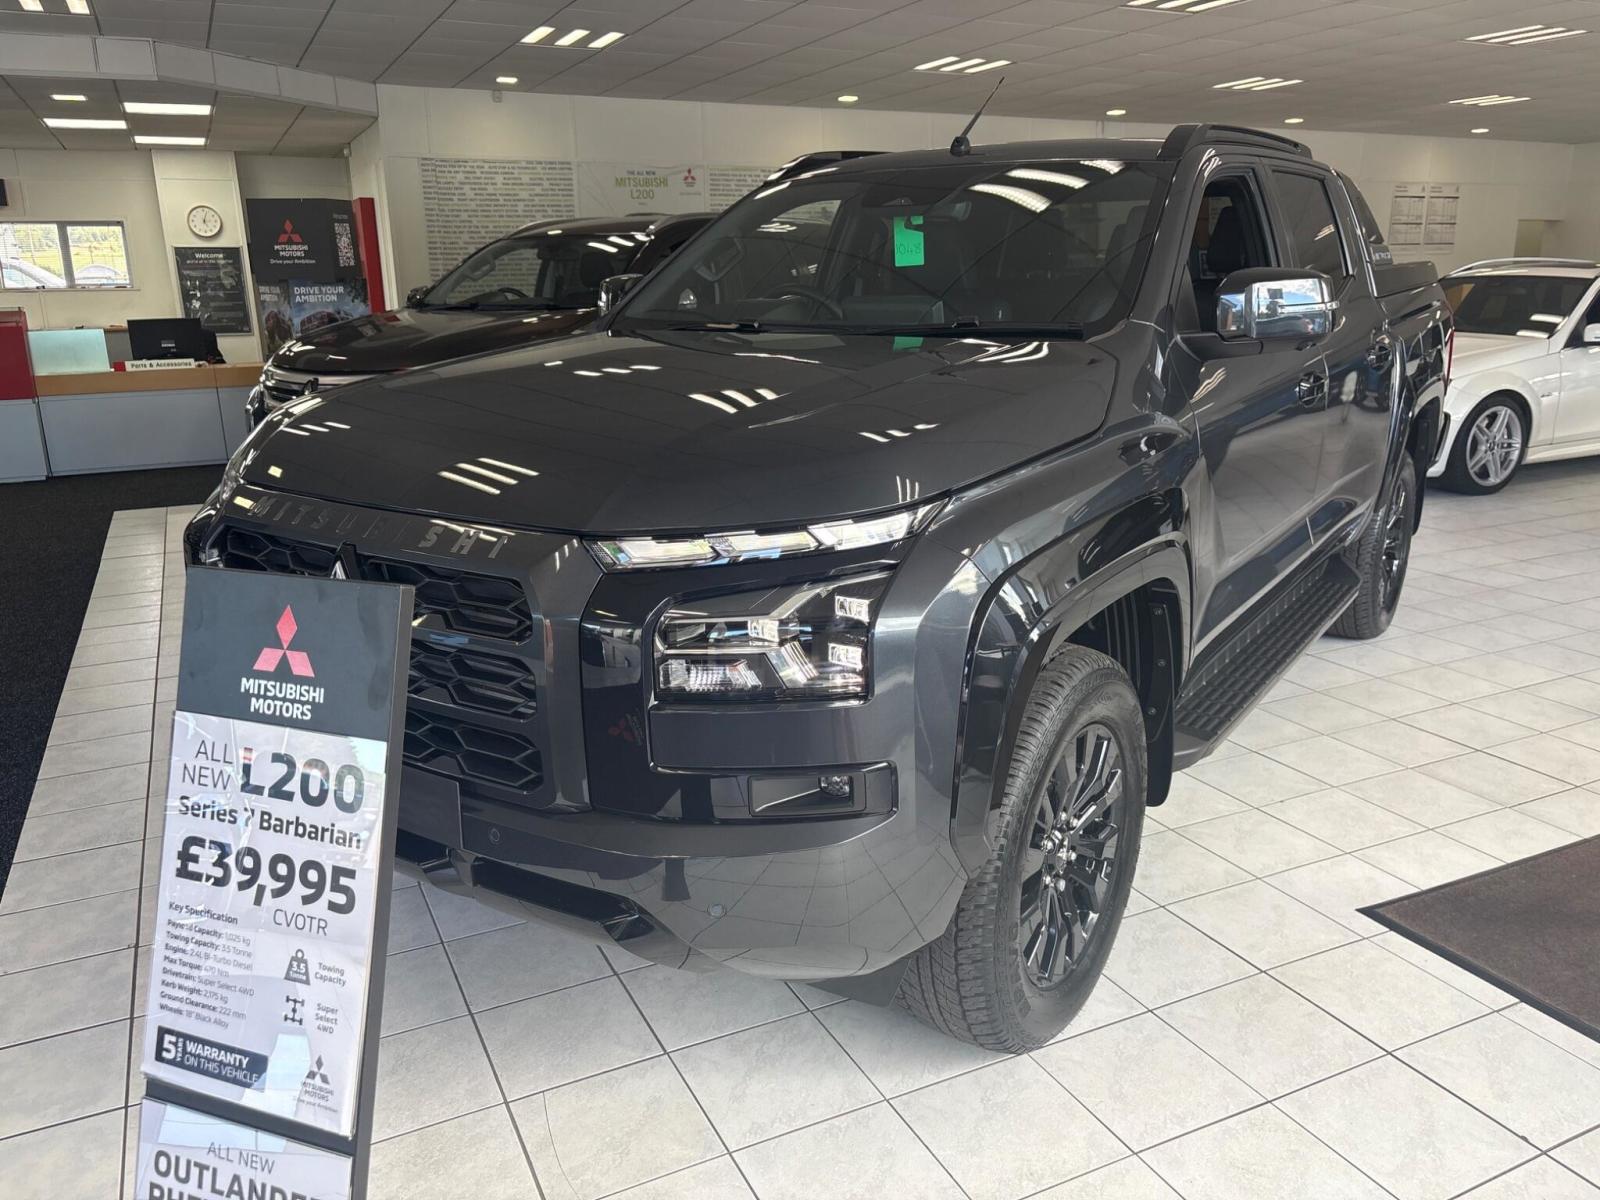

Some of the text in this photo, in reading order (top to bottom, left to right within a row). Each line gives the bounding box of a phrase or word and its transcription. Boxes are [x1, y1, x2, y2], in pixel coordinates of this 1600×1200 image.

[615, 176, 669, 188] MITSUBISHI
[630, 190, 655, 200] L200
[296, 294, 338, 303] AMBITION
[322, 286, 344, 294] YOUR
[240, 677, 324, 704] MITSUBISHI
[250, 697, 312, 720] MOTORS
[195, 740, 233, 765] ALL
[182, 763, 231, 791] NEW
[240, 747, 365, 814] L200
[179, 795, 238, 825] Series
[259, 811, 361, 849] Barbarian
[176, 835, 357, 915] £39,995
[168, 901, 238, 925] Key Specification
[273, 909, 328, 936] CVOTR
[165, 942, 189, 954] Engine:
[166, 930, 190, 945] Towing
[191, 936, 221, 951] Capacity:
[164, 955, 177, 965] Max
[291, 960, 306, 973] 3.5
[318, 962, 345, 976] Towing
[161, 979, 177, 989] Kerb
[198, 975, 216, 987] Super
[217, 980, 237, 993] Select
[315, 971, 347, 987] Capacity
[160, 991, 185, 1003] Ground
[317, 1003, 338, 1016] Super
[212, 1017, 229, 1029] Alloy
[315, 1013, 338, 1026] Select
[316, 1023, 334, 1034] 4WD
[162, 1033, 177, 1060] 5
[186, 1040, 250, 1069] WARRANTY
[184, 1054, 259, 1083] ON THIS VEHICLE
[304, 1089, 329, 1102] MOTORS
[207, 1142, 276, 1174] ALL NEW
[154, 1150, 321, 1200] OUTLAND
